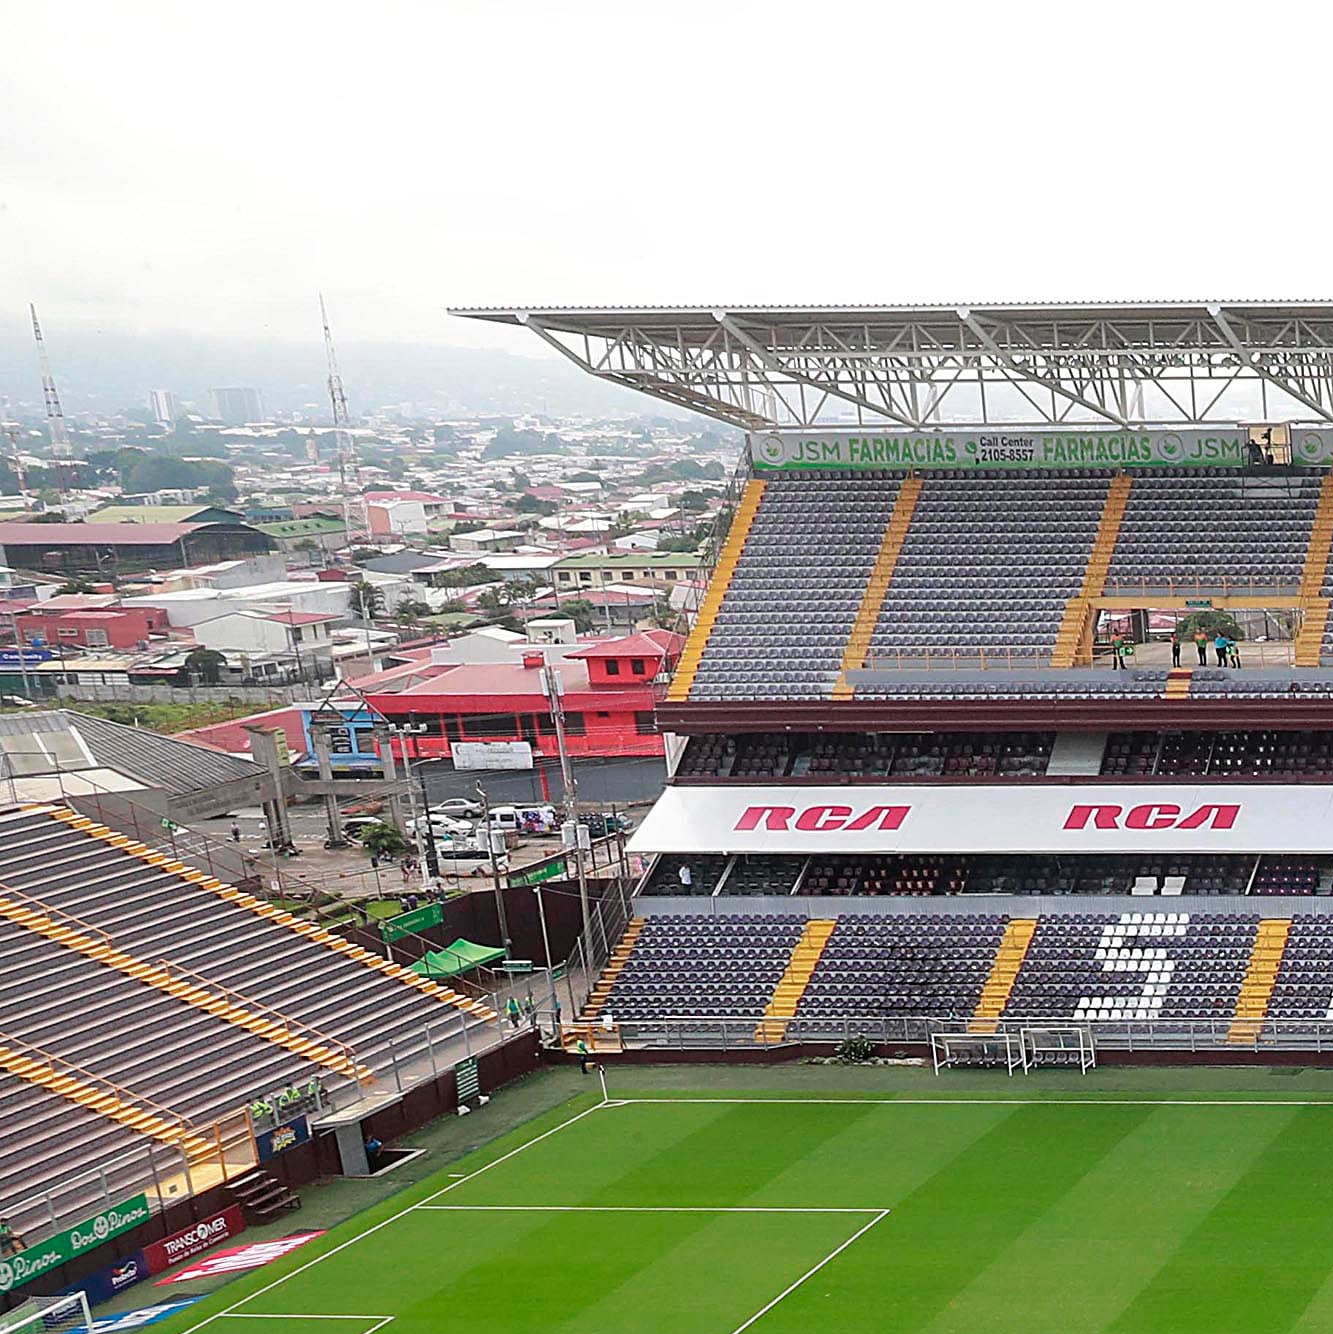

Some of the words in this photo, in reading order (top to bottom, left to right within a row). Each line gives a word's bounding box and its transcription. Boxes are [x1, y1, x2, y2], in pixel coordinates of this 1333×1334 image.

[792, 441, 840, 461] JSM
[849, 438, 957, 462] FARMACIAS
[980, 437, 998, 447] Call
[1001, 437, 1034, 447] Center
[1043, 437, 1152, 462] FARMACIAS
[1190, 438, 1240, 459] JSM
[981, 449, 1034, 462] 2105-8557
[736, 805, 911, 832] RCA
[1064, 804, 1241, 831] RCA
[71, 1231, 97, 1250] Dos
[108, 1207, 147, 1232] Pinos
[13, 1250, 62, 1281] Pinos
